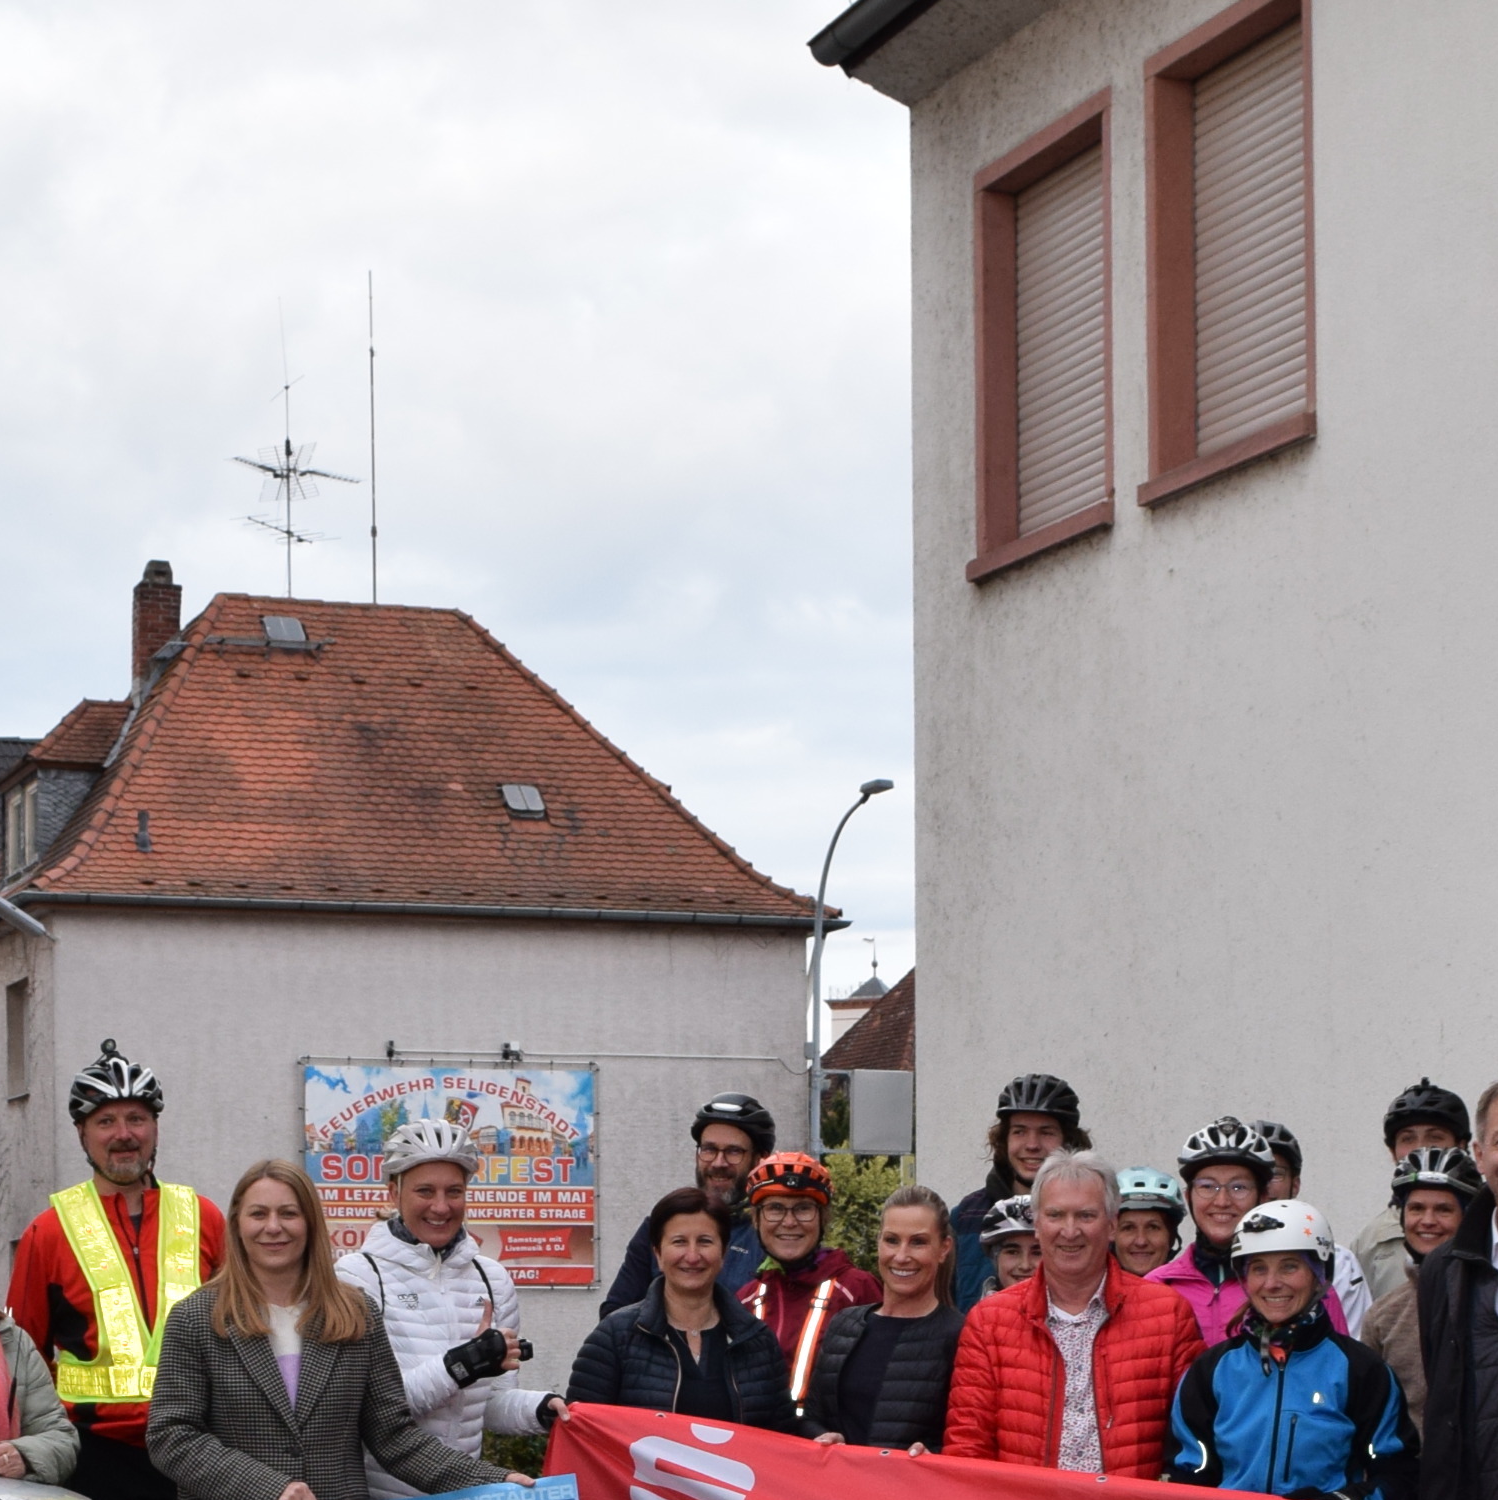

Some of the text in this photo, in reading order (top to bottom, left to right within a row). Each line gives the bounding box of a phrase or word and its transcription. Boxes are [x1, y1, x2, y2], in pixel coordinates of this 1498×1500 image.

[319, 1076, 580, 1141] FEUERWEHR SELIGENSTADT
[533, 1191, 552, 1202] IM
[558, 1192, 586, 1203] MAI
[507, 1236, 546, 1245] Samstags
[505, 1244, 543, 1252] Livemusik
